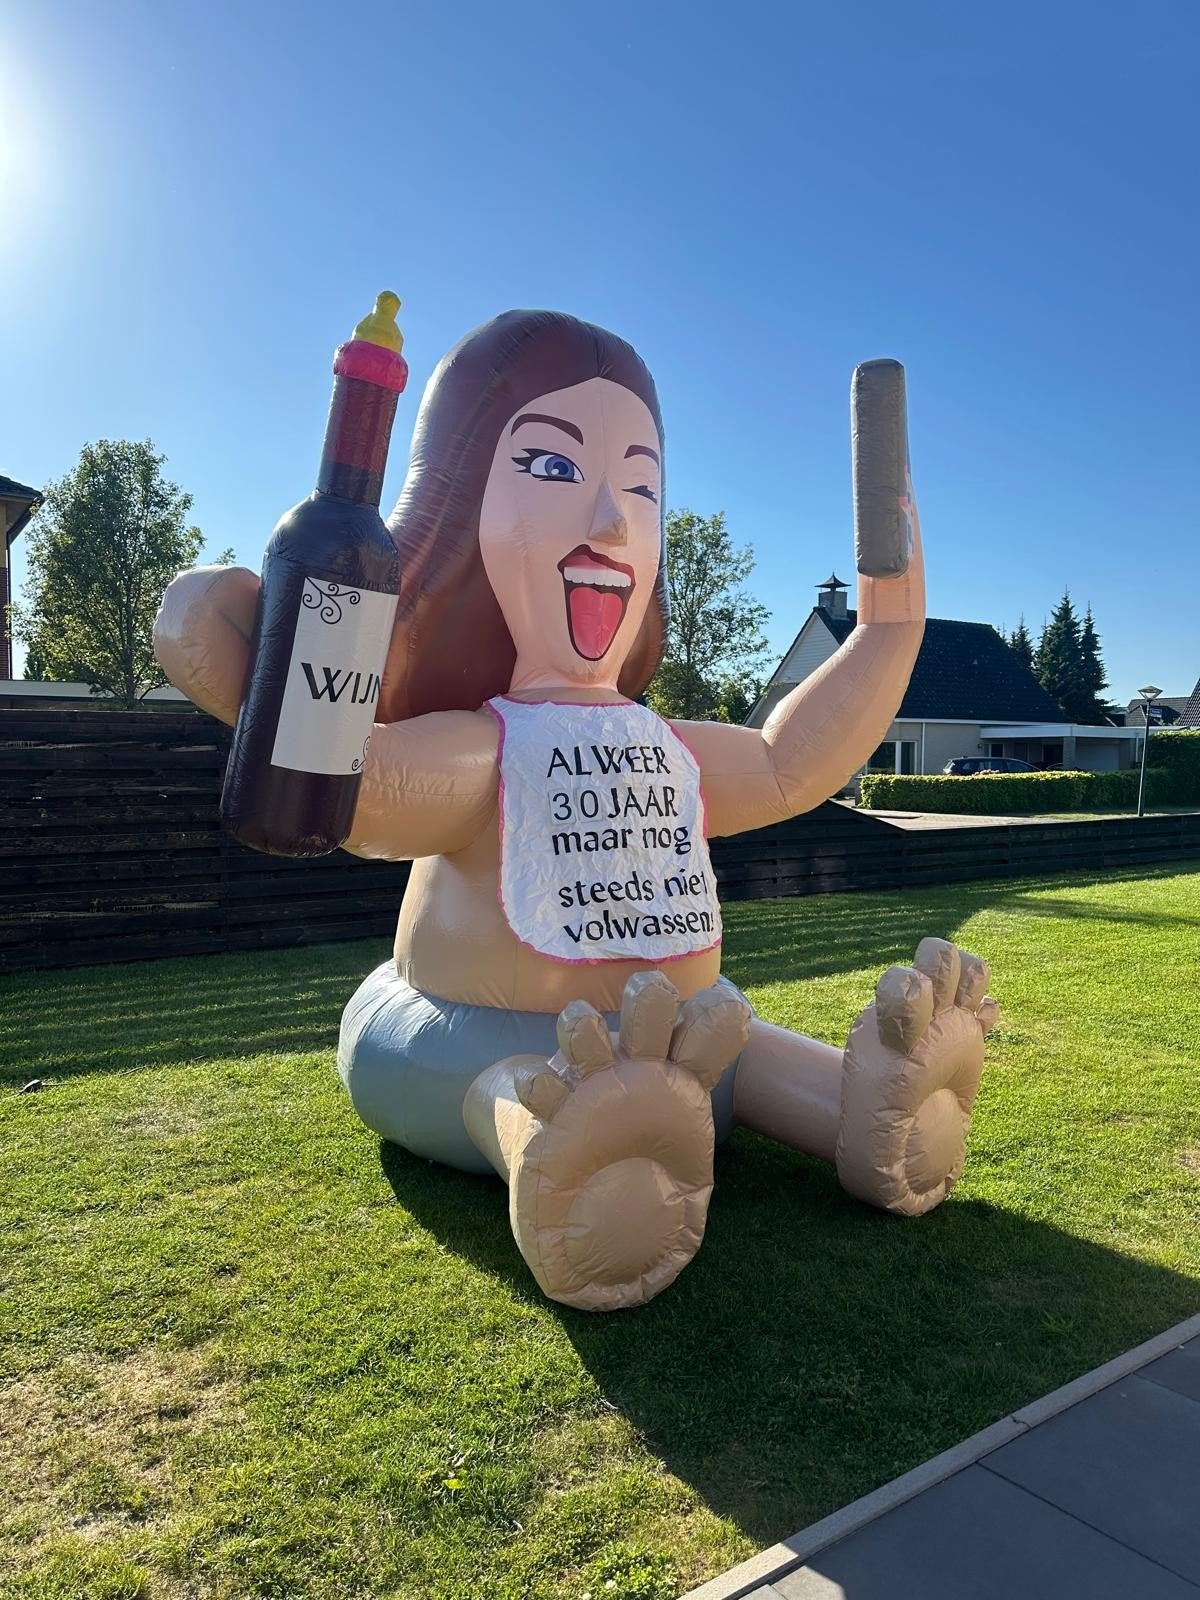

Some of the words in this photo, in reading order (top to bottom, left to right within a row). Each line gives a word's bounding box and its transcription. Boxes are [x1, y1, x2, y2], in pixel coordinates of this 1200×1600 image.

[547, 745, 671, 777] ALWEER
[552, 789, 599, 821] 30
[607, 786, 679, 819] JAAR
[551, 828, 634, 855] maar
[642, 826, 692, 855] nog
[558, 871, 655, 908] steeds
[664, 868, 708, 897] niet
[563, 909, 714, 943] volwassen!
